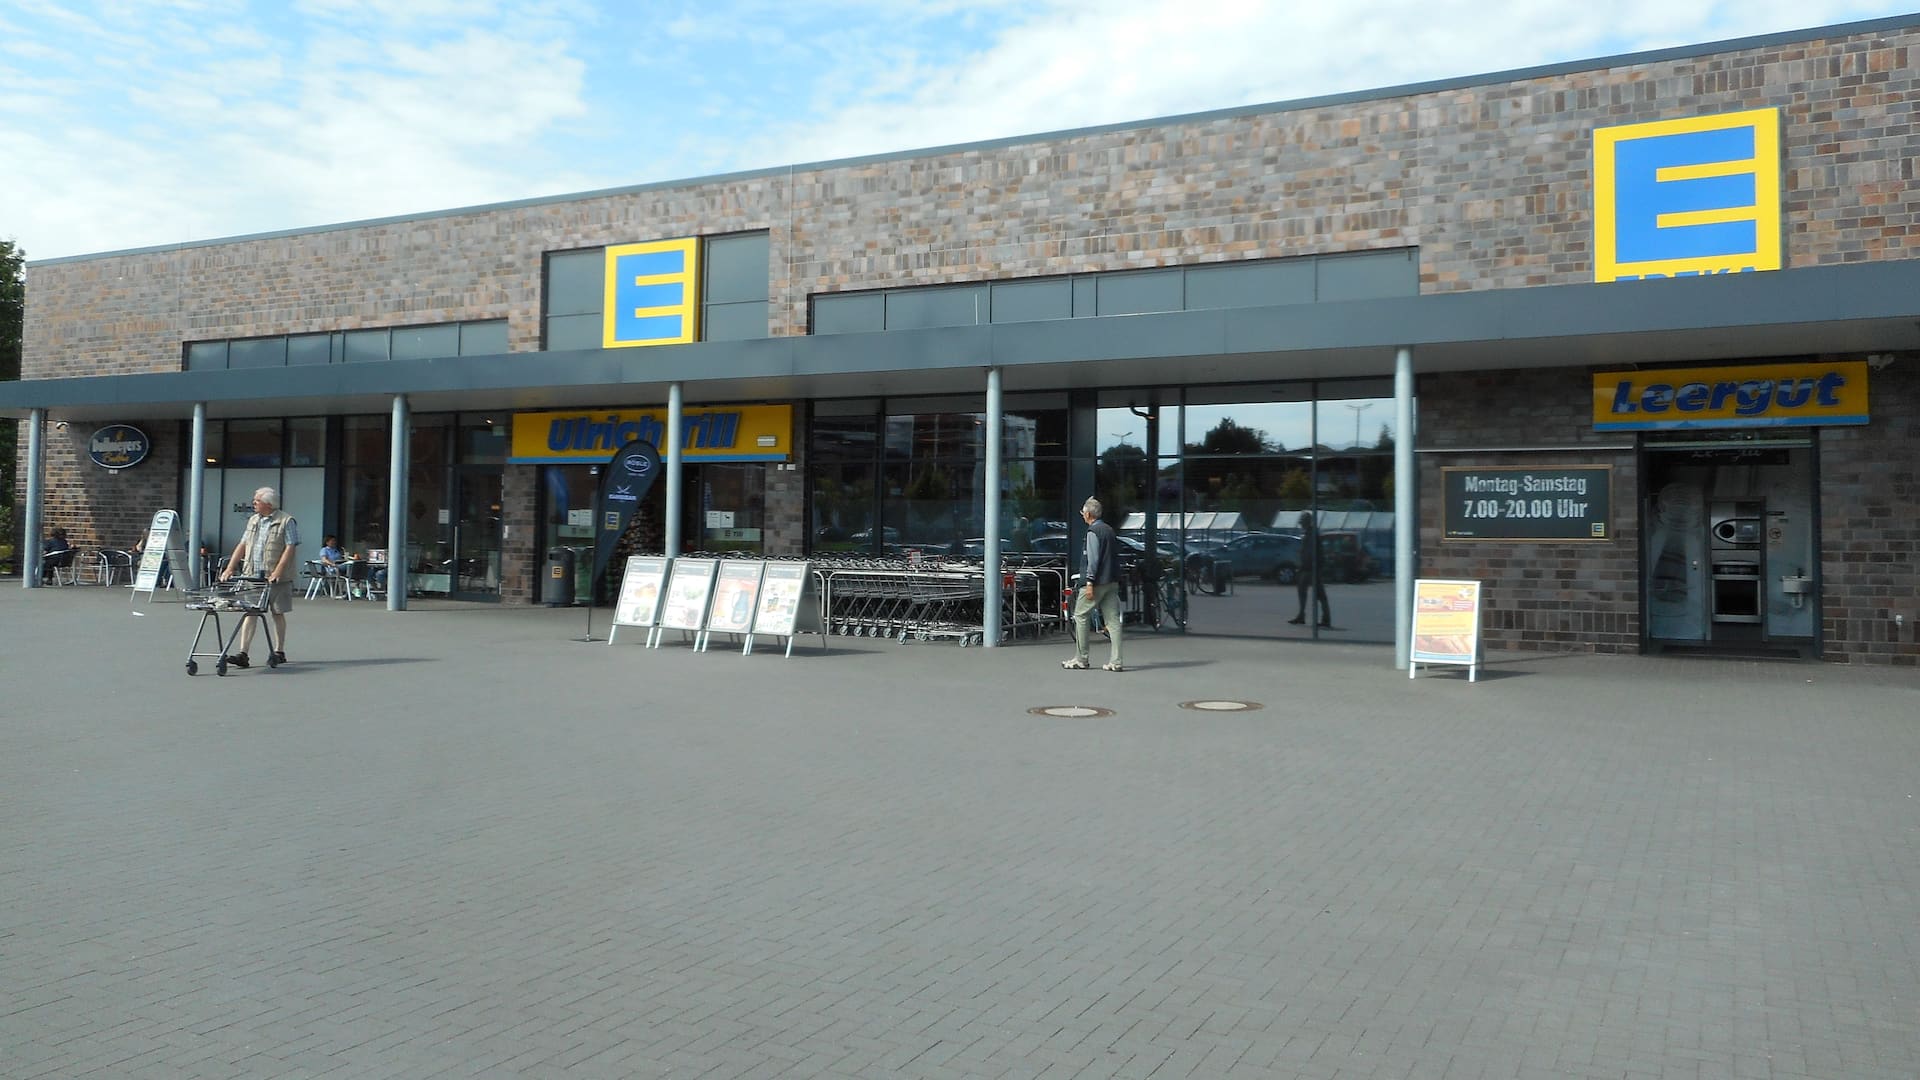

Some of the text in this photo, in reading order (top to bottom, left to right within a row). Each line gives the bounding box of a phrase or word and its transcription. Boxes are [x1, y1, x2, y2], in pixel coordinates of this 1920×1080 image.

[1614, 125, 1757, 264] E
[615, 249, 684, 342] E
[1611, 371, 1846, 416] Leergut
[547, 415, 664, 451] Ulrich
[1465, 475, 1587, 496] Montag-Samstag
[1464, 499, 1588, 518] 7.00-20.00 Uhr
